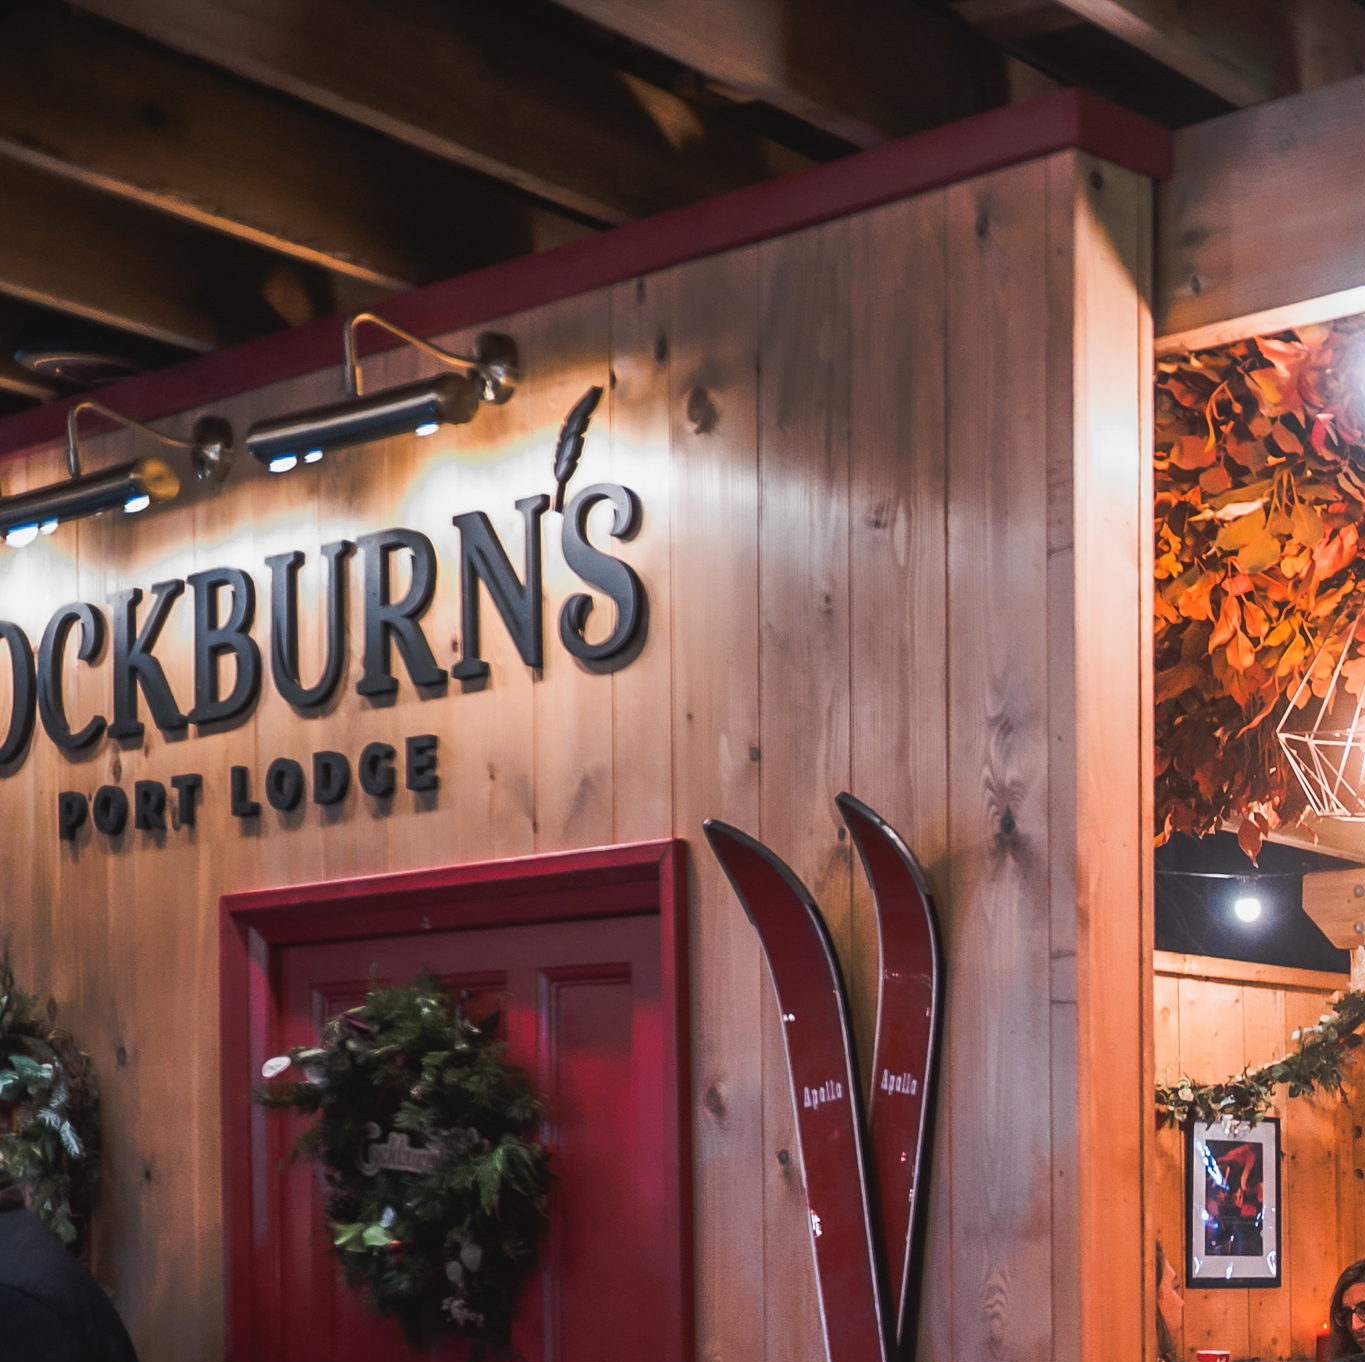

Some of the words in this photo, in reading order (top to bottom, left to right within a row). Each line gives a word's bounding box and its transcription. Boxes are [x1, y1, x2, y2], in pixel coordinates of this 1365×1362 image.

[58, 773, 202, 840] PORT
[230, 734, 439, 818] LODGE
[803, 1080, 842, 1110] Apollo
[881, 1069, 918, 1096] Apollo
